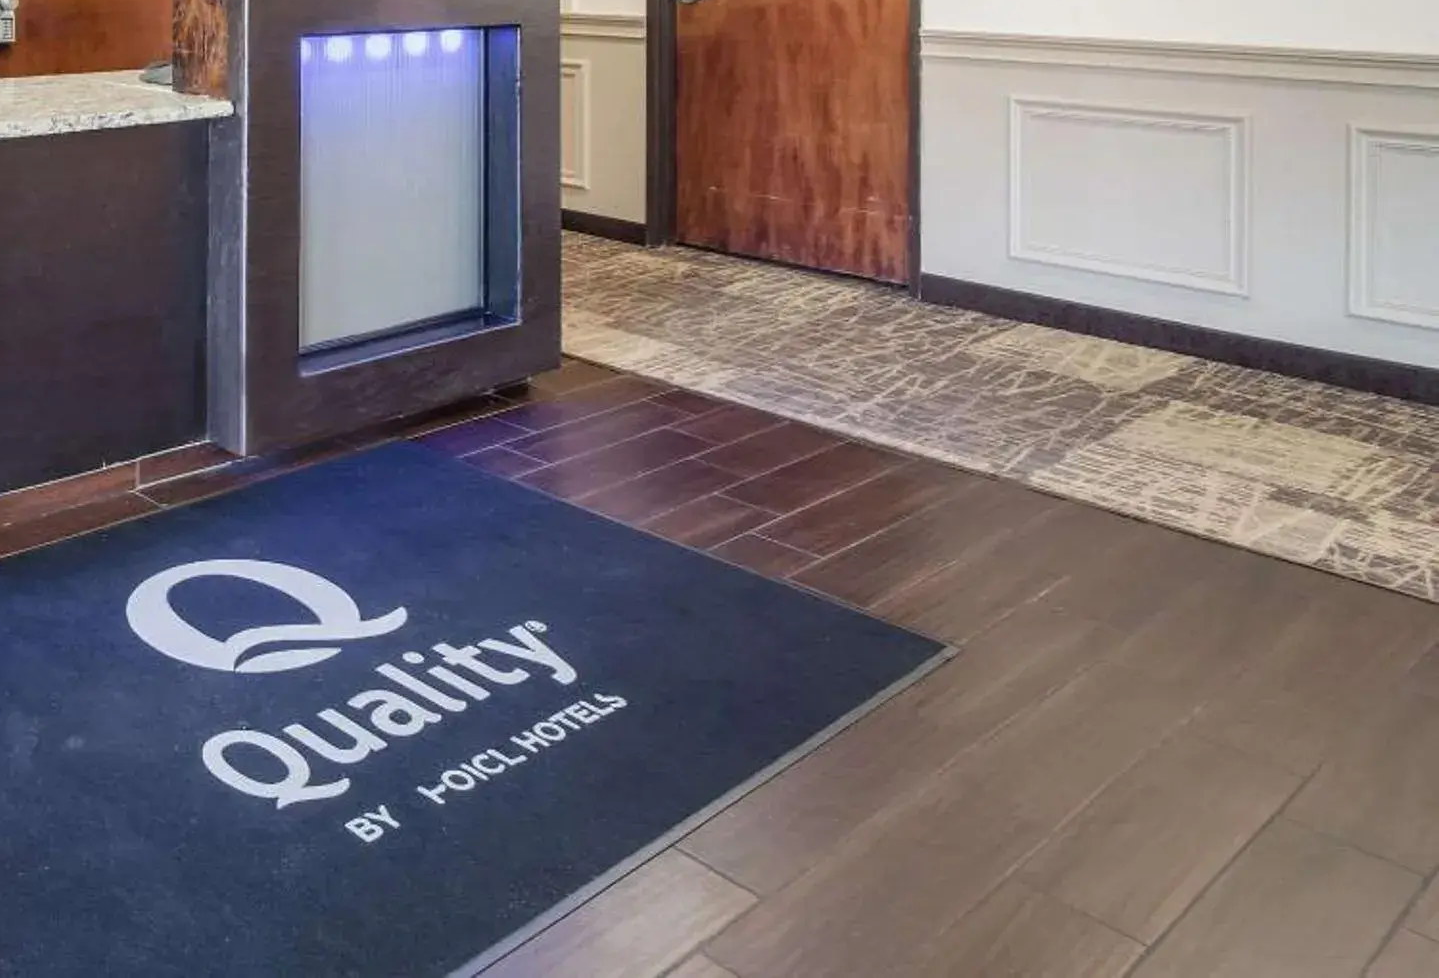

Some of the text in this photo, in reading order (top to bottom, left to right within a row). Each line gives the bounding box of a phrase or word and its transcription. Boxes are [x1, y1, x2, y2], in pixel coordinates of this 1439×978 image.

[125, 558, 409, 674] Q
[201, 622, 578, 810] Quality
[344, 804, 401, 843] BY
[509, 693, 628, 753] HOTELS
